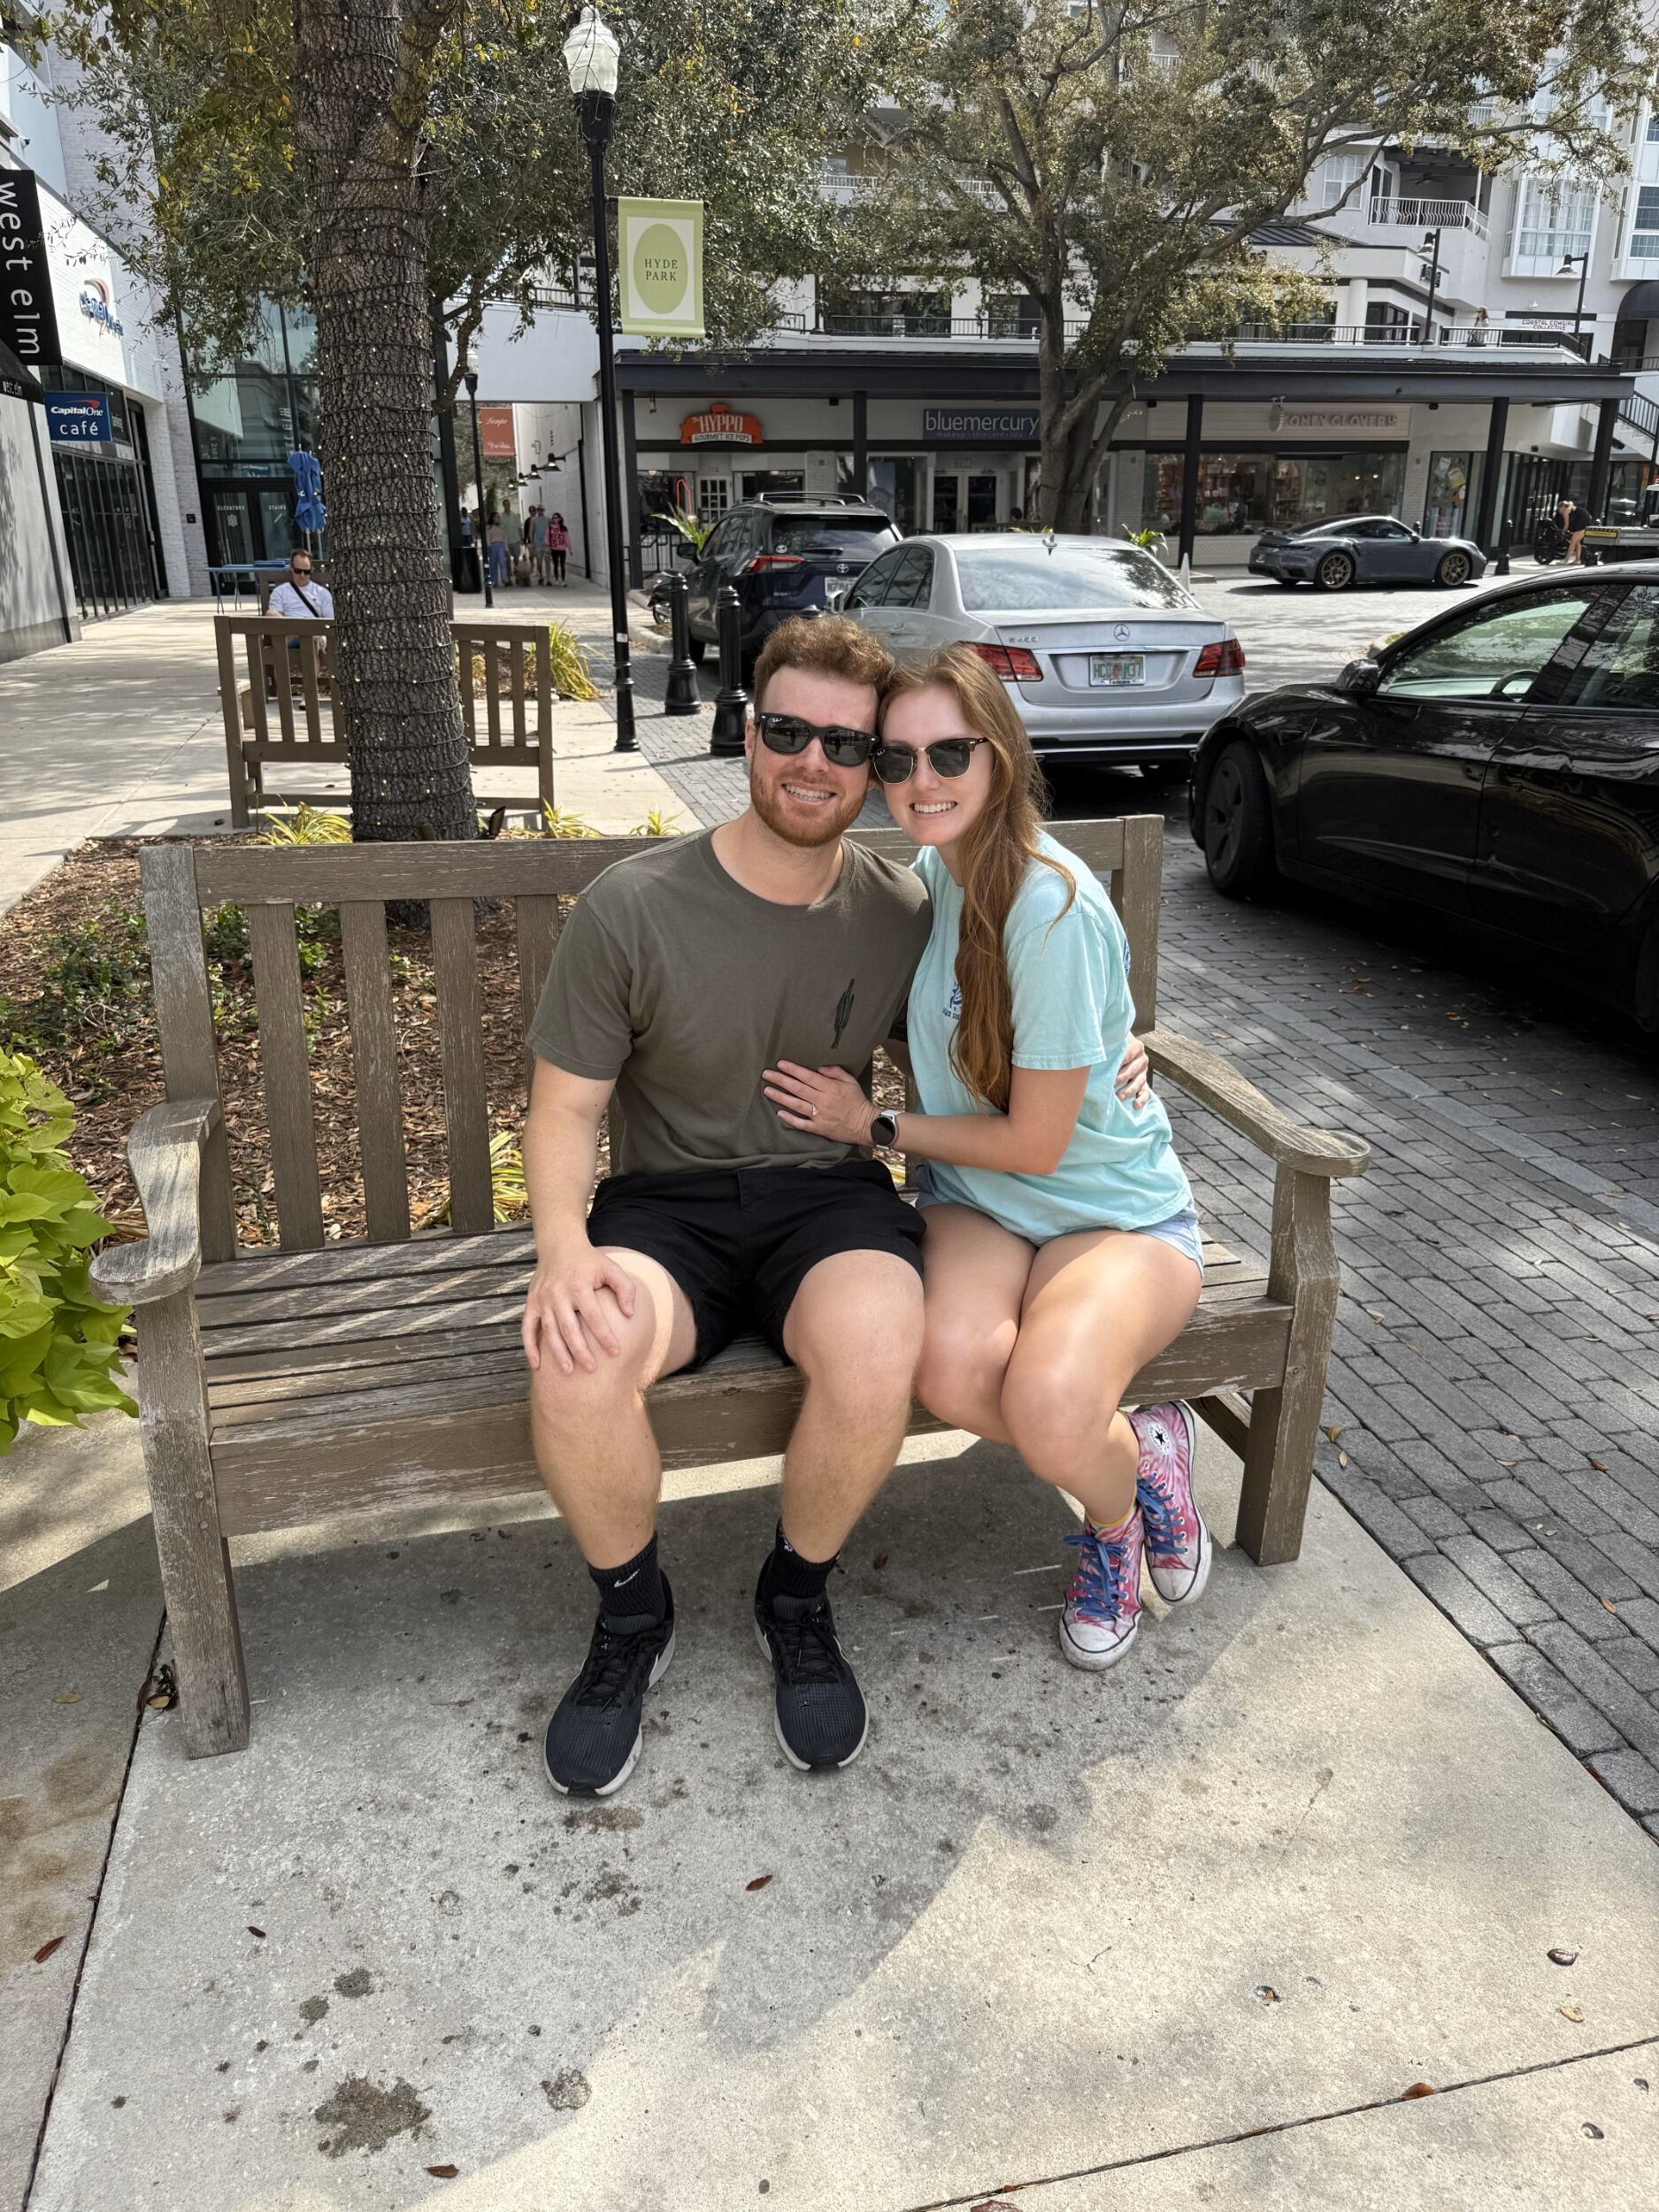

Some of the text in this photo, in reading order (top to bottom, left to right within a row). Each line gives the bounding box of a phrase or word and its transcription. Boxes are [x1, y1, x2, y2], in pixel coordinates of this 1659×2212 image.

[0, 181, 41, 354] west elm
[644, 258, 678, 269] HYDE
[646, 271, 677, 281] PARK
[59, 421, 98, 435] café
[699, 414, 743, 433] HYPPO
[926, 411, 1040, 435] bluemercury
